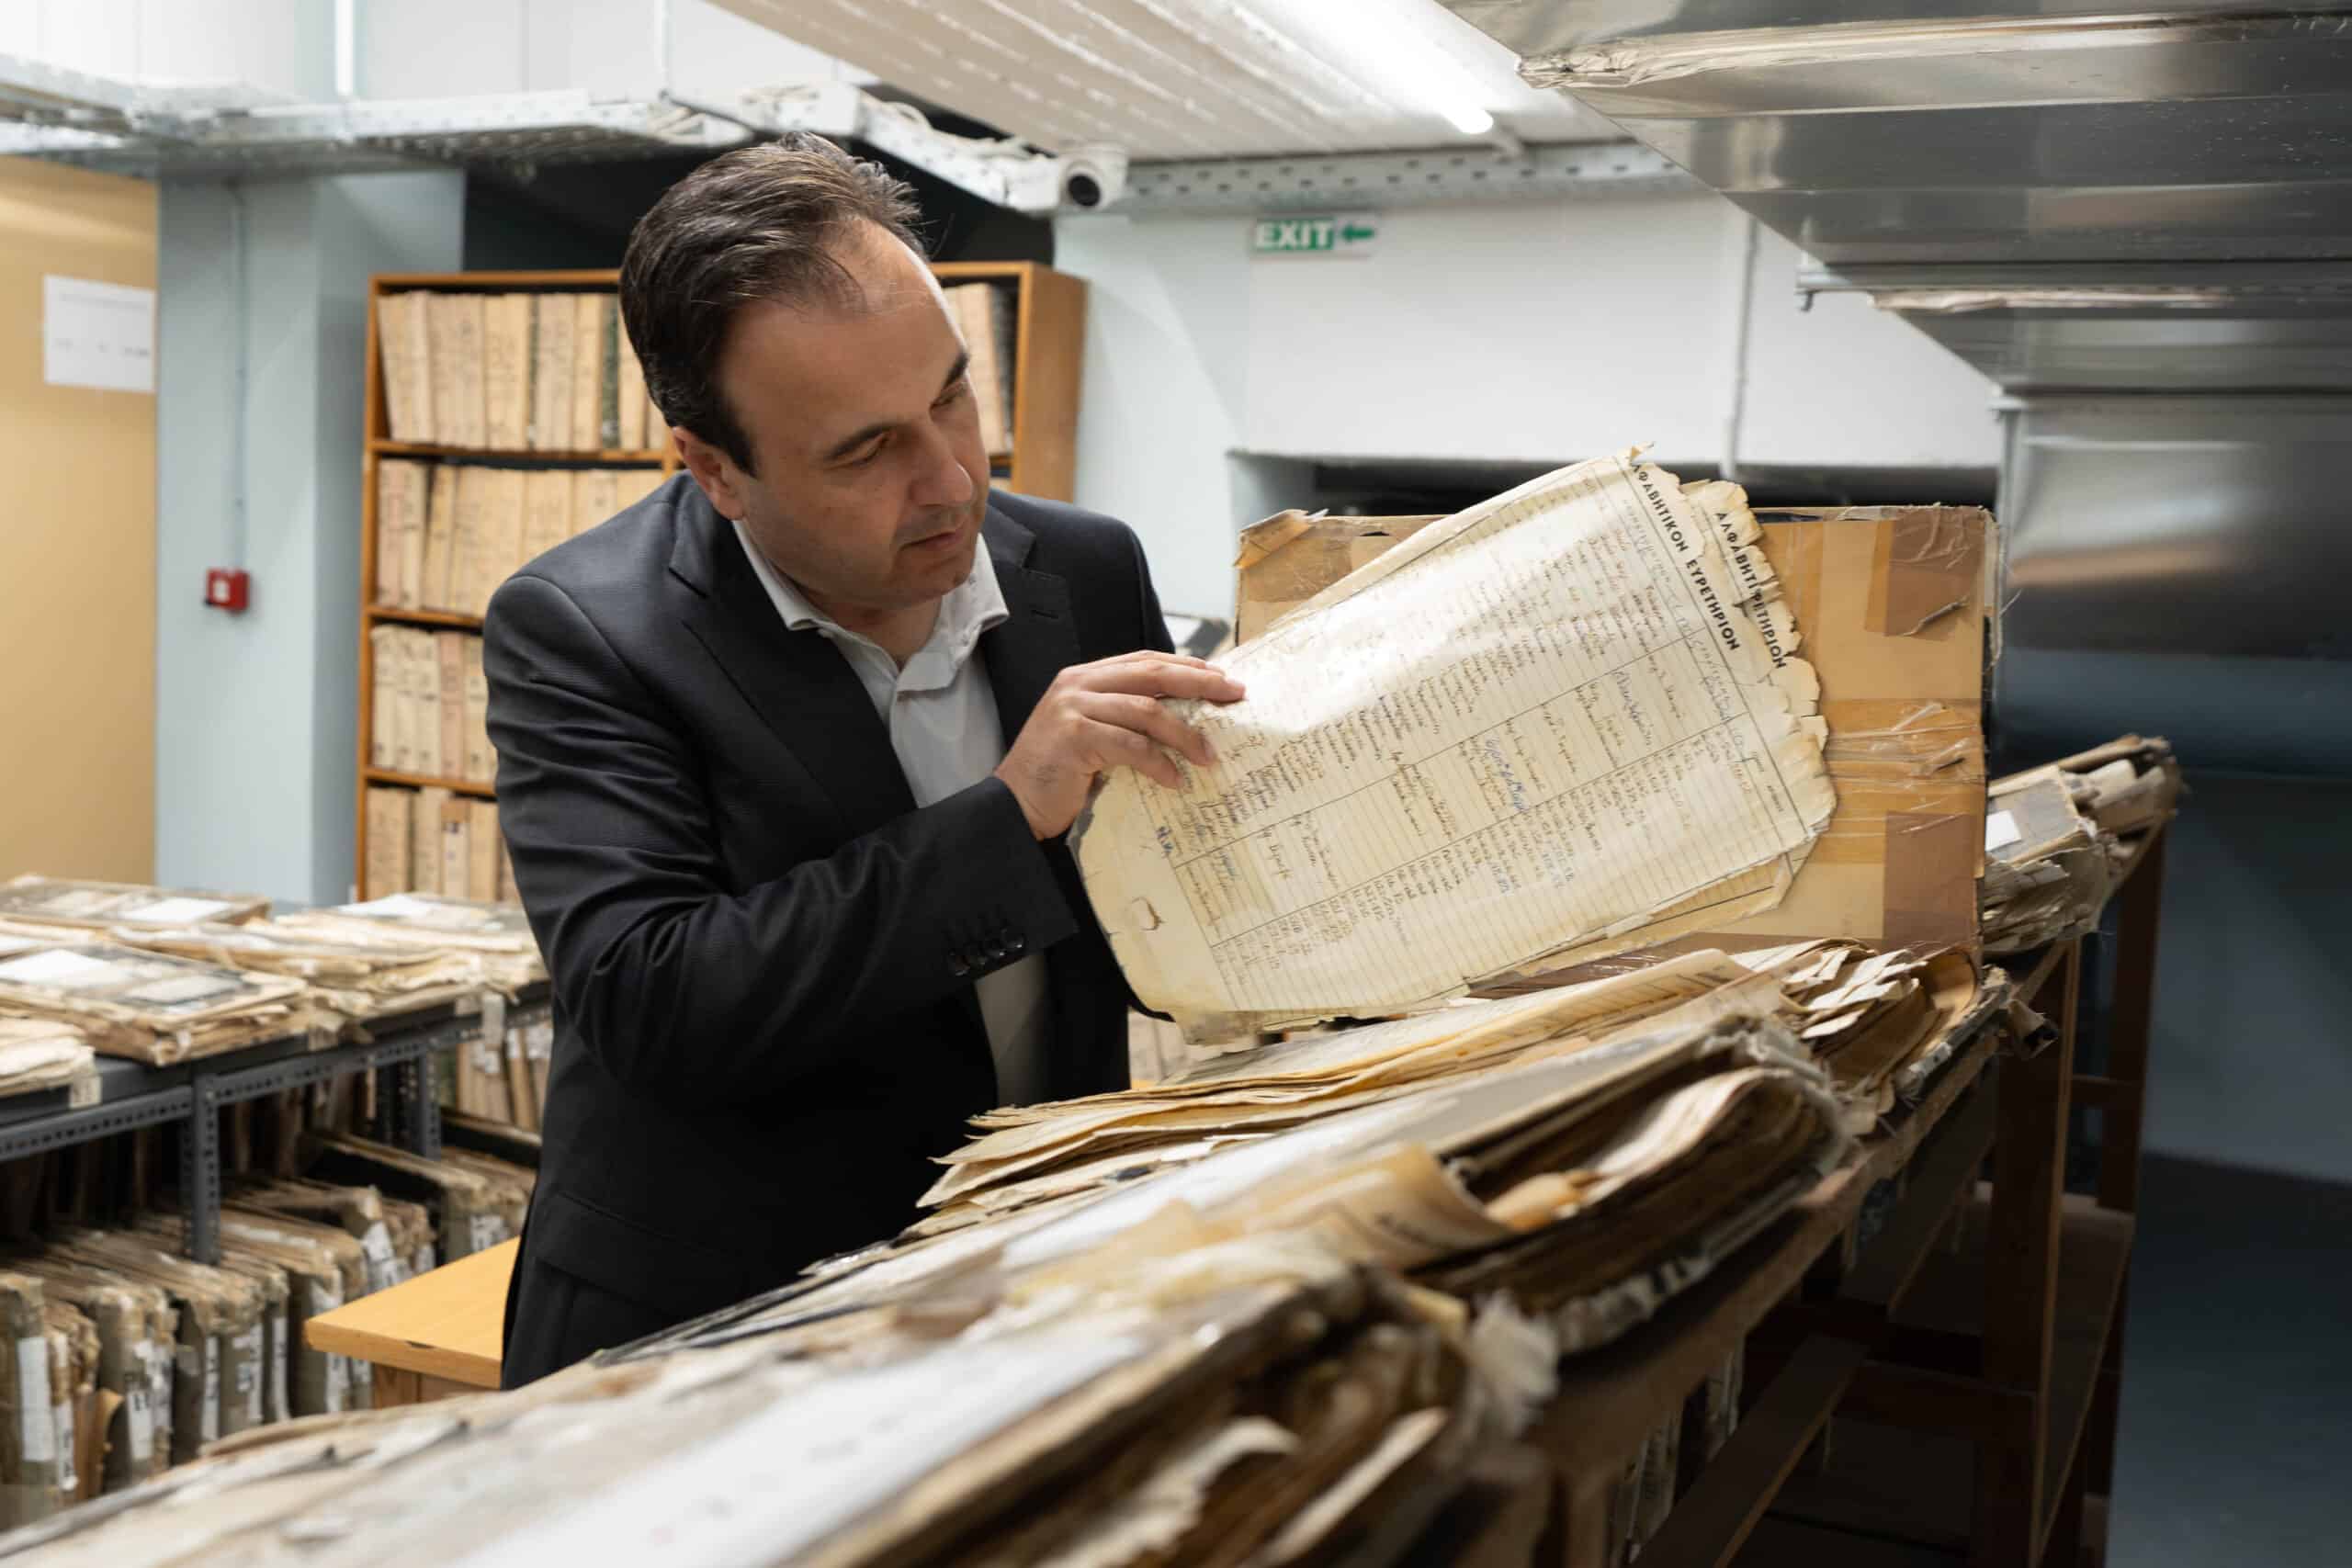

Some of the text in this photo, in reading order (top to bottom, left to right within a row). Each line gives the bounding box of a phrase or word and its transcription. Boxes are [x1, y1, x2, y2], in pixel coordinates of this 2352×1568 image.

[1256, 221, 1332, 249] EXIT
[1631, 464, 1690, 552] ΛΦΑΒΗΤΙΚΟΝ
[1686, 558, 1740, 651] ΕΥΡΕΤΗΡΙΟΝ
[1715, 512, 1760, 592] ΑΛΦΑΒΗΤΙ
